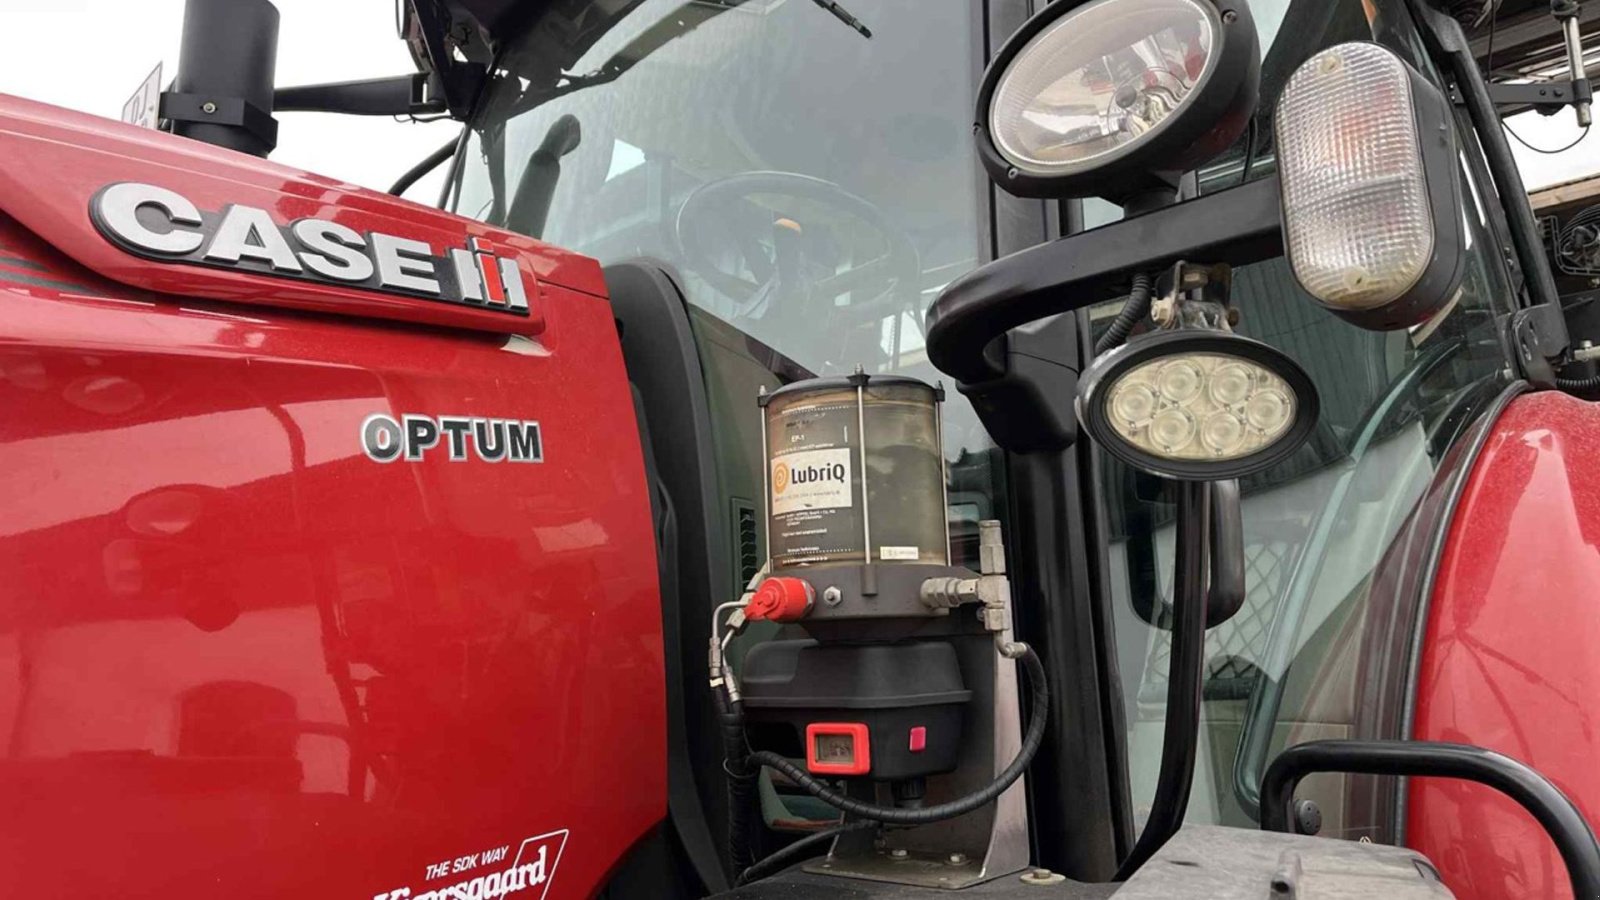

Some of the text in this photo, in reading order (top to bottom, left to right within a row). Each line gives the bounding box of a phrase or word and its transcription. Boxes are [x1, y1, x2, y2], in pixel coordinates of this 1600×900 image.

[97, 181, 441, 295] CASE
[360, 413, 544, 464] OPTUM
[791, 462, 846, 485] LubriQ
[373, 845, 547, 900] rsgaard
[425, 845, 509, 881] THE SDK WAY
